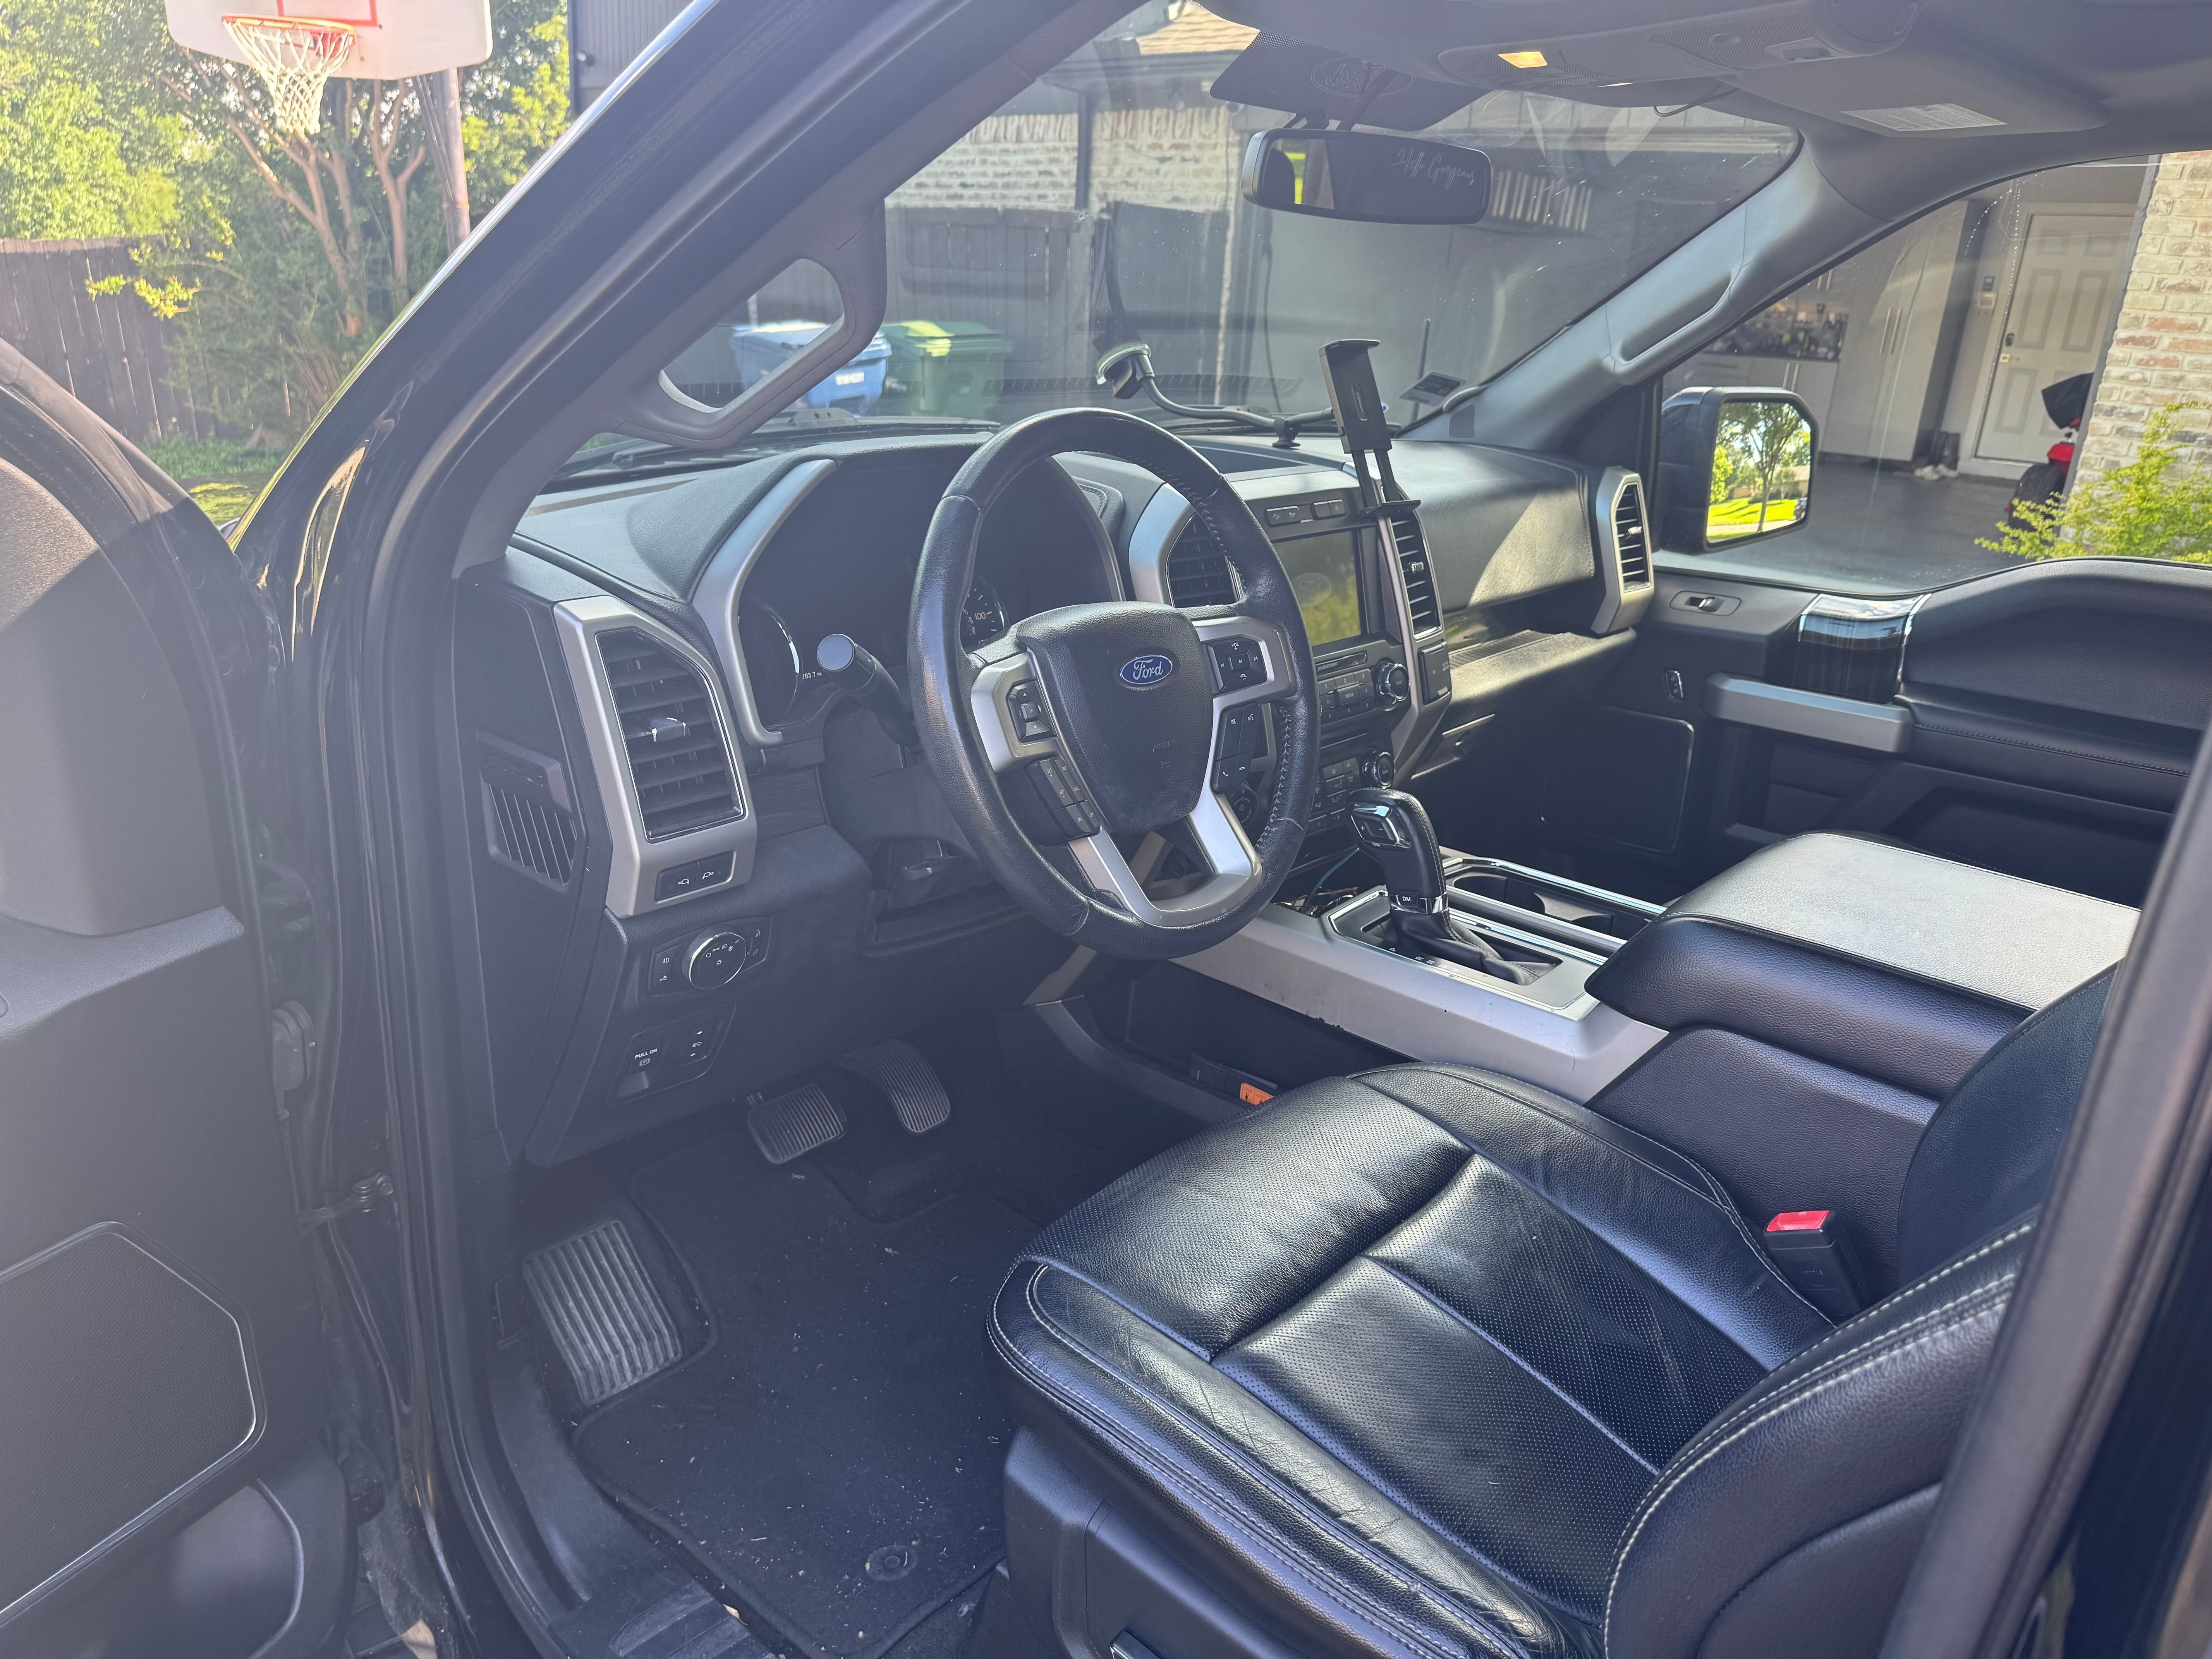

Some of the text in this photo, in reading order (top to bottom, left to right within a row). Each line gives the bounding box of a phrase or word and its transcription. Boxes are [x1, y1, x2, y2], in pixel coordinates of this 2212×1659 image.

[1390, 148, 1426, 177] Hello
[975, 612, 986, 620] 100
[1133, 659, 1163, 680] Ford
